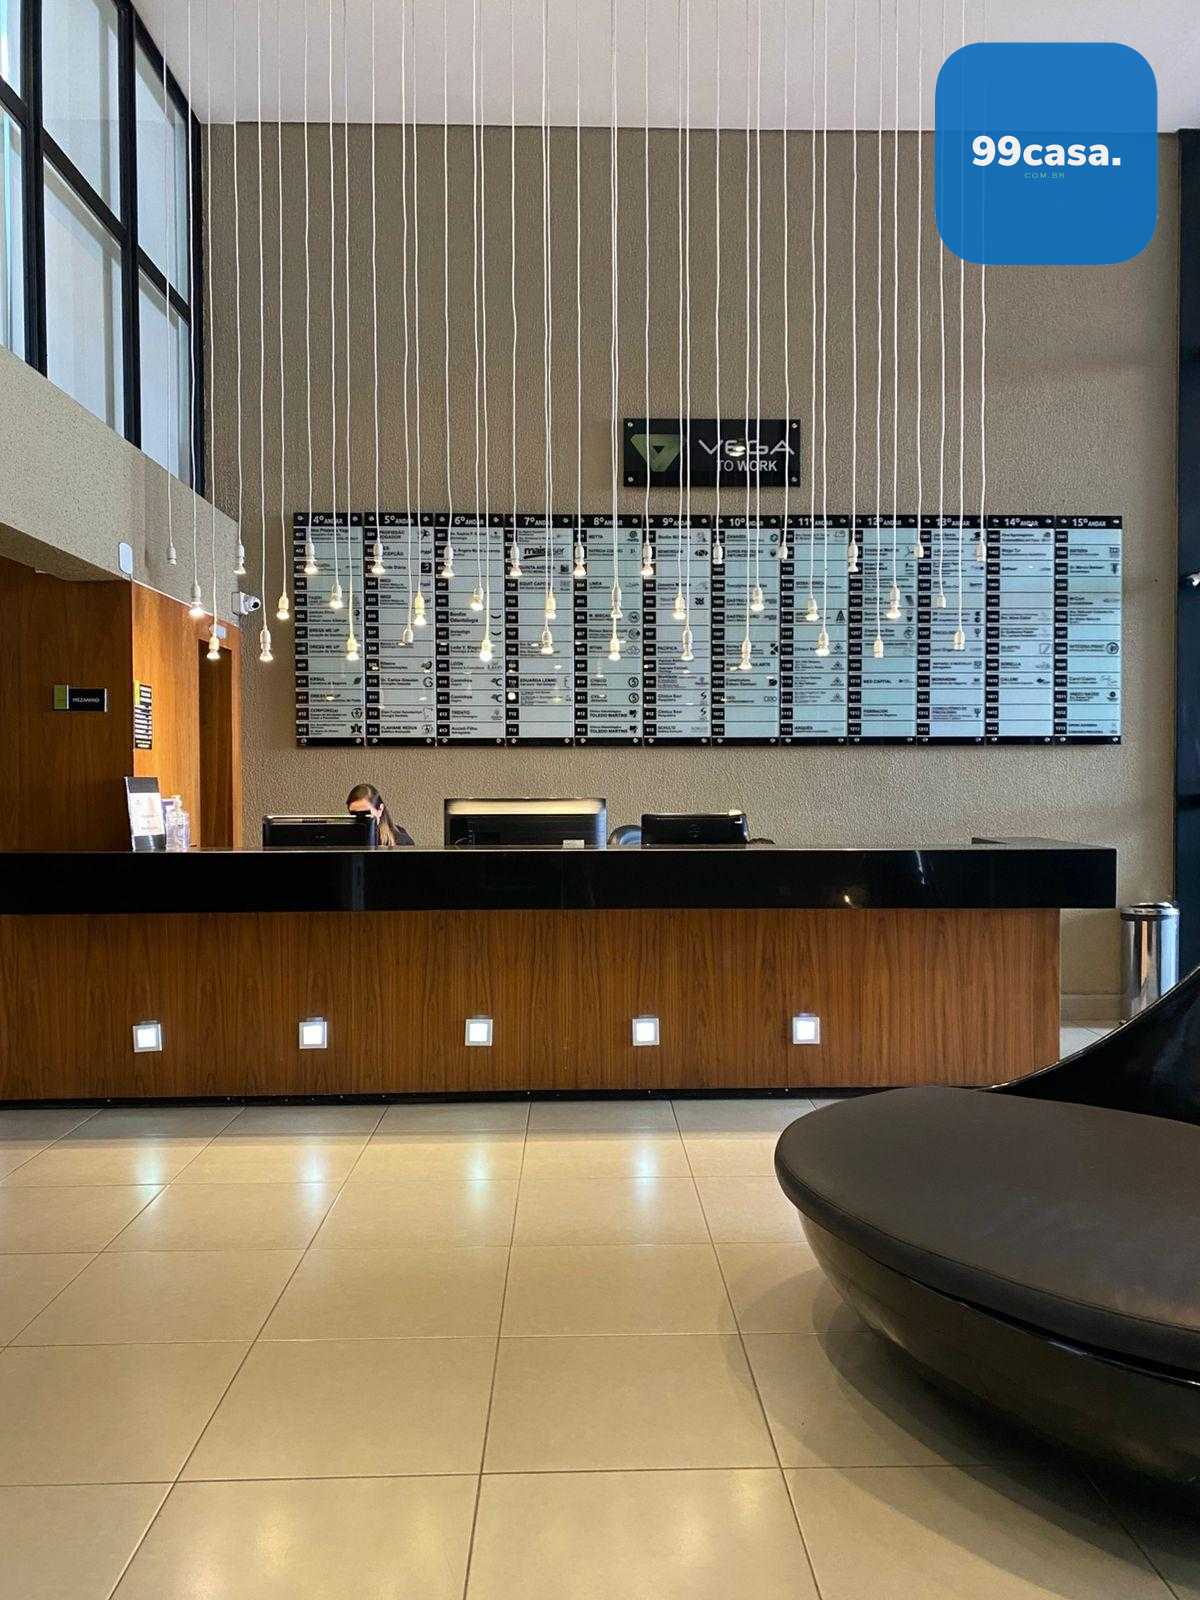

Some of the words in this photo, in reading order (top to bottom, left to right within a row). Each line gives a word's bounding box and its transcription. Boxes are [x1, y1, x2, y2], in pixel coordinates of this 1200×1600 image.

[699, 439, 795, 455] VEGA
[717, 460, 733, 472] TO
[737, 460, 777, 472] WORK
[1072, 518, 1088, 527] 15º
